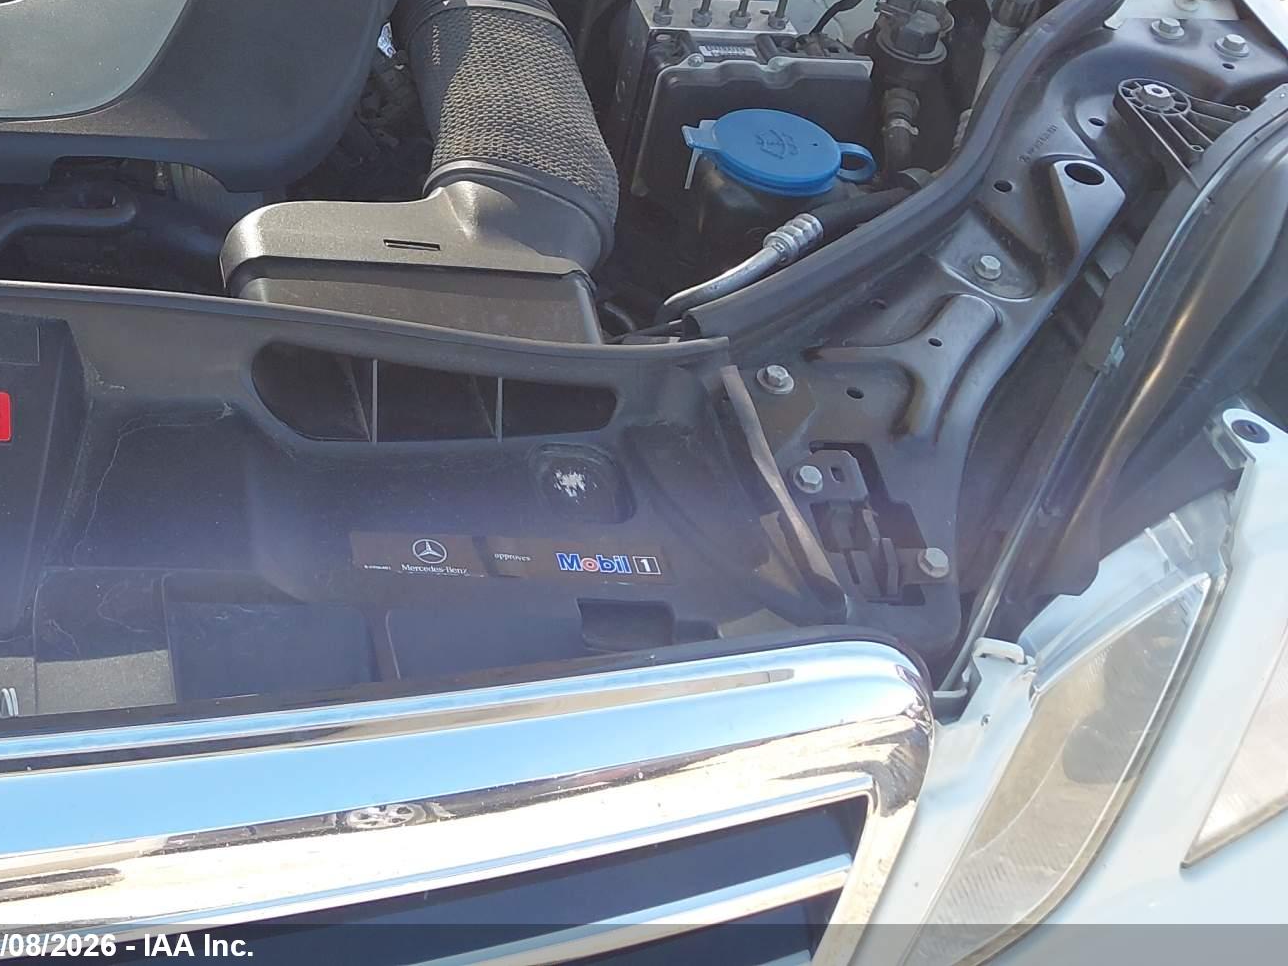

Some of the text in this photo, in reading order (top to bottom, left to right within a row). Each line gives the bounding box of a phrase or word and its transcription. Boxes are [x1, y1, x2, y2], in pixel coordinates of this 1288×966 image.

[494, 553, 531, 562] approves
[555, 552, 633, 574] Mobil
[401, 563, 467, 574] Mercedes-Benz
